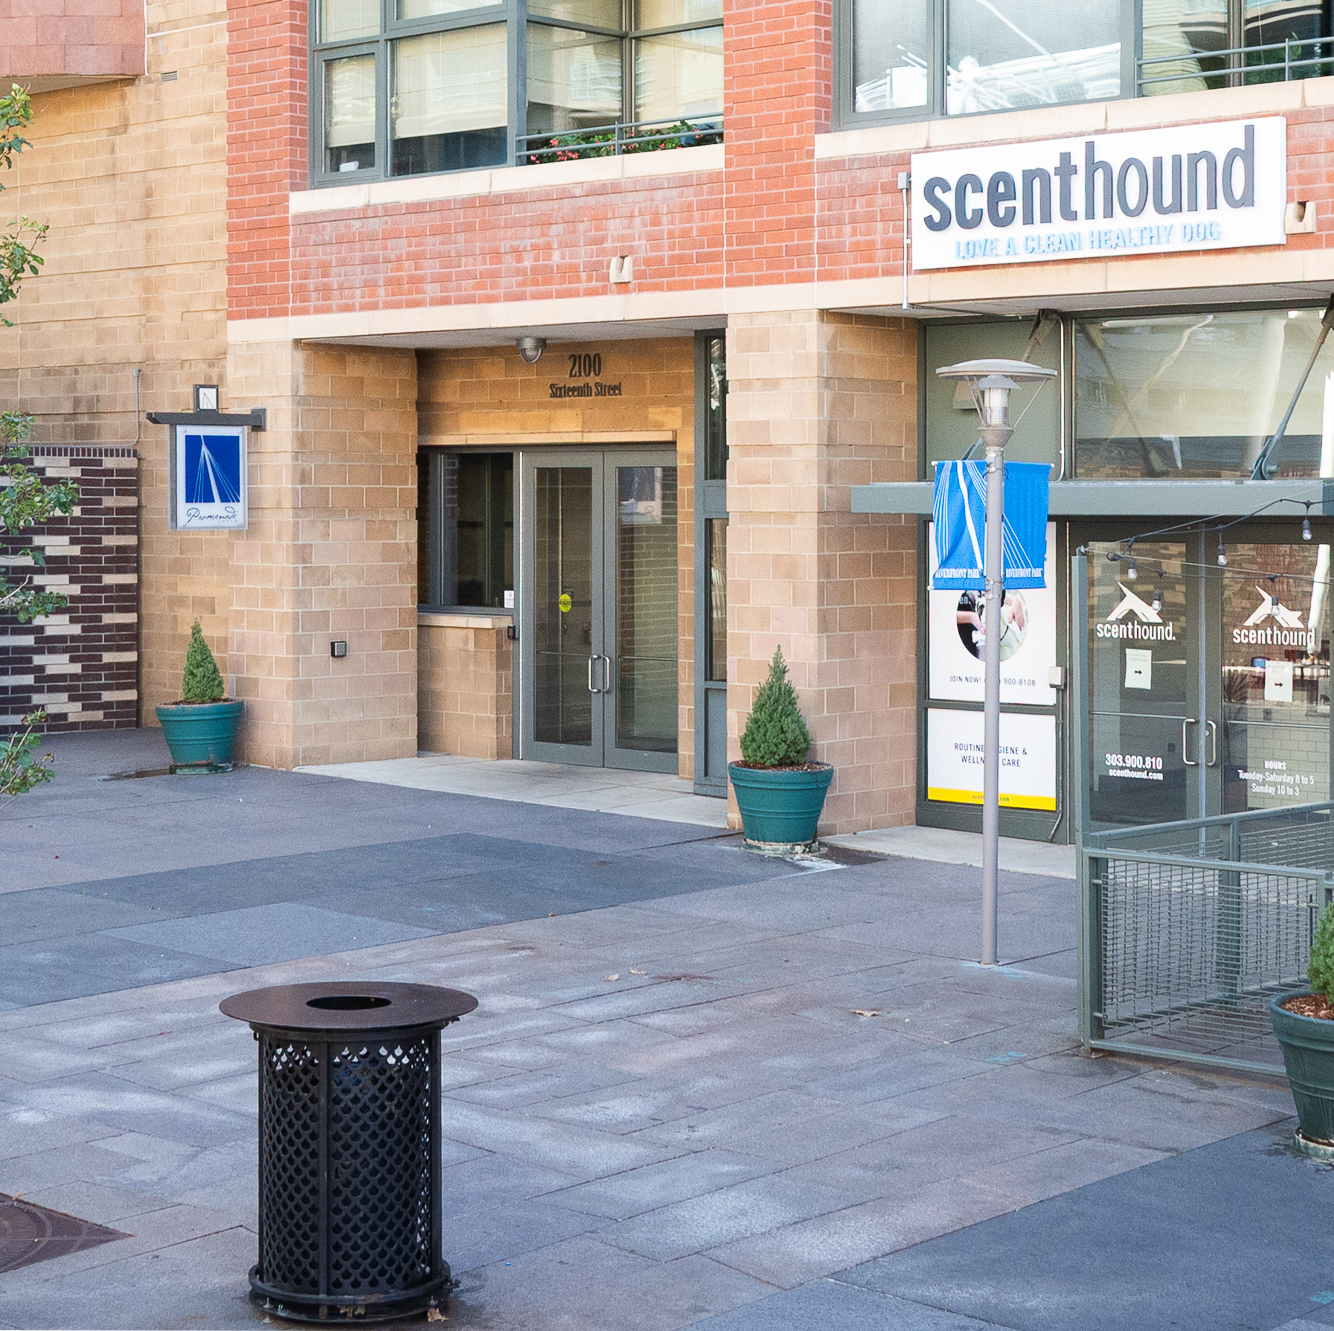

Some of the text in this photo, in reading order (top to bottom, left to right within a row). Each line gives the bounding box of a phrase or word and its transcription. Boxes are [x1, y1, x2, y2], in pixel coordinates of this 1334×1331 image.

[923, 125, 1255, 232] scenthound
[955, 221, 1221, 259] LOVE A CLEAN HEALTHY DOG
[568, 353, 602, 378] 2100
[549, 382, 622, 398] Sixteenth Street
[1096, 620, 1176, 641] scenthound.
[1232, 626, 1316, 646] scenthound
[949, 675, 963, 683] JOIN
[954, 743, 984, 753] ROUTINE
[998, 745, 1019, 755] GIENE
[1002, 758, 1021, 767] CARE
[1105, 754, 1162, 770] 303.900.810
[1264, 761, 1287, 771] HOURS
[1108, 769, 1164, 780] scenthound.com
[1238, 770, 1294, 785] Tuesday-Saturday
[1301, 775, 1309, 784] to
[1310, 775, 1315, 785] 5
[1251, 783, 1300, 796] Sunday 10 to 3
